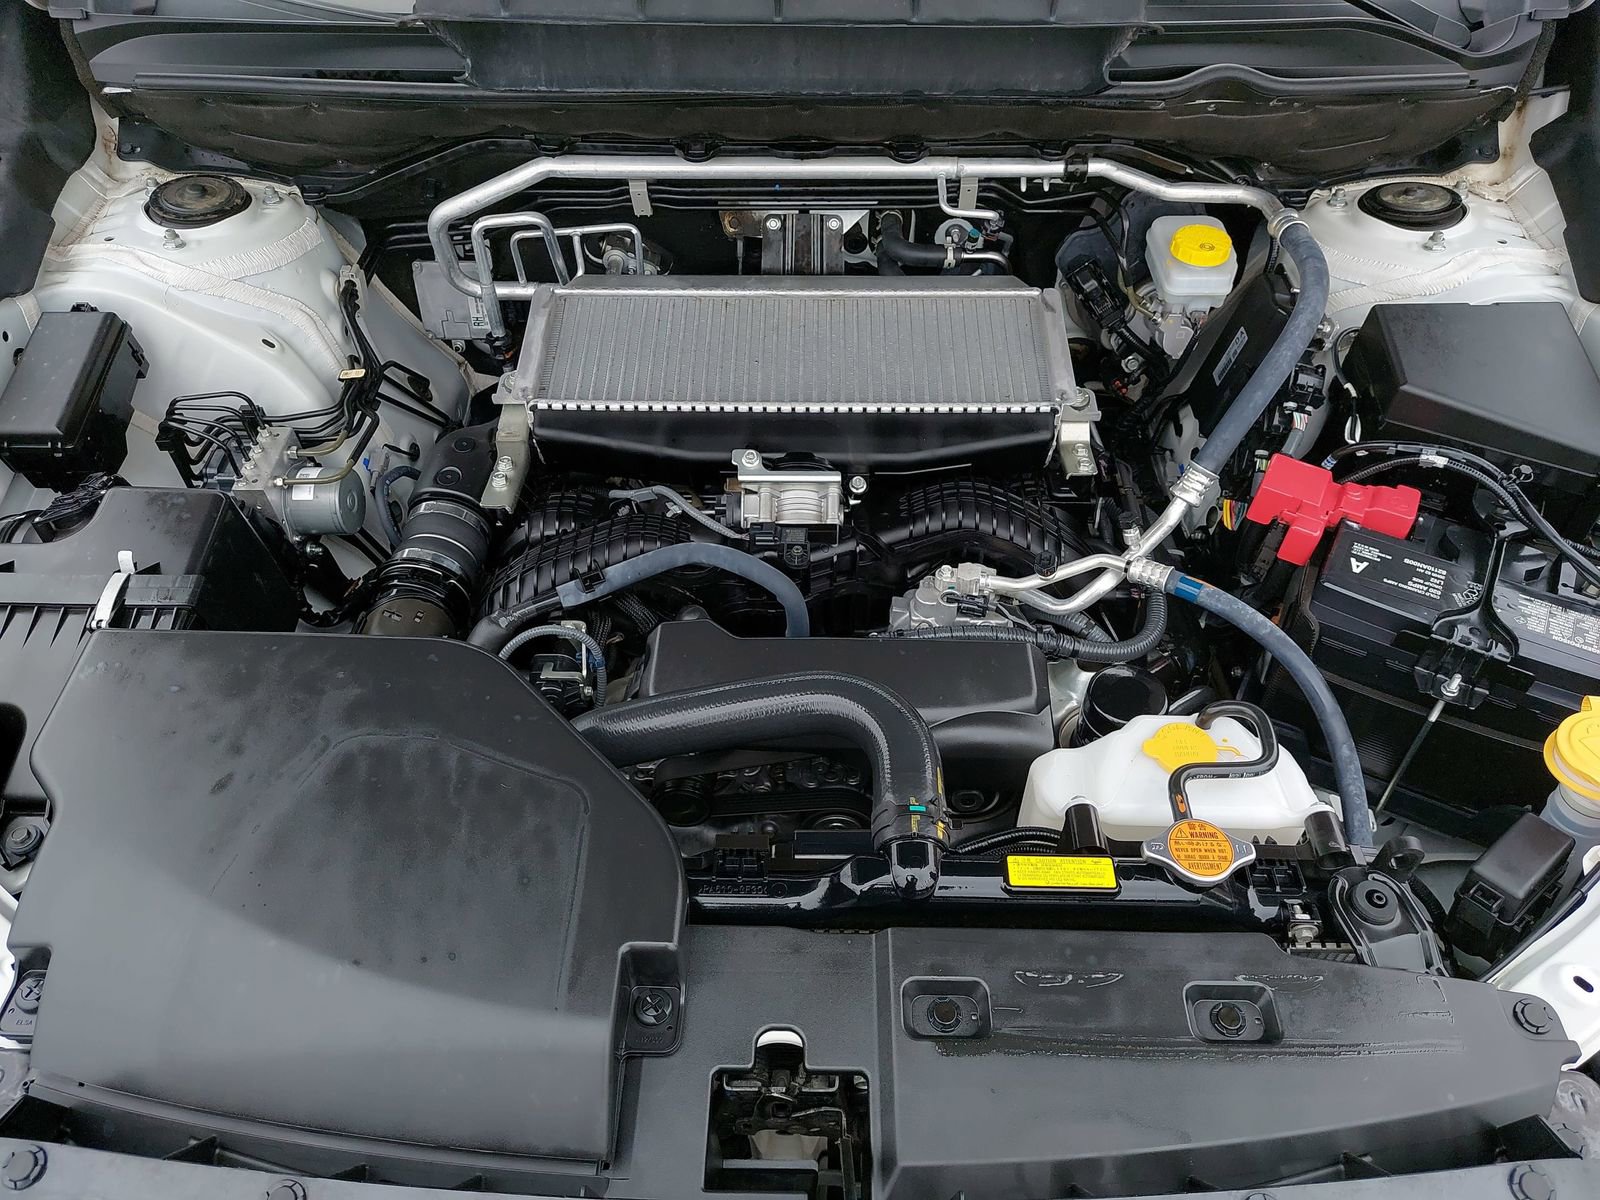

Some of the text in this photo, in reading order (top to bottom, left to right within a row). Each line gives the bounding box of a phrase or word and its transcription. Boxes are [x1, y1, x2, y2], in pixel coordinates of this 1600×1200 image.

[472, 317, 484, 326] RH
[1407, 580, 1428, 591] AMPS
[1188, 831, 1219, 839] WARNING
